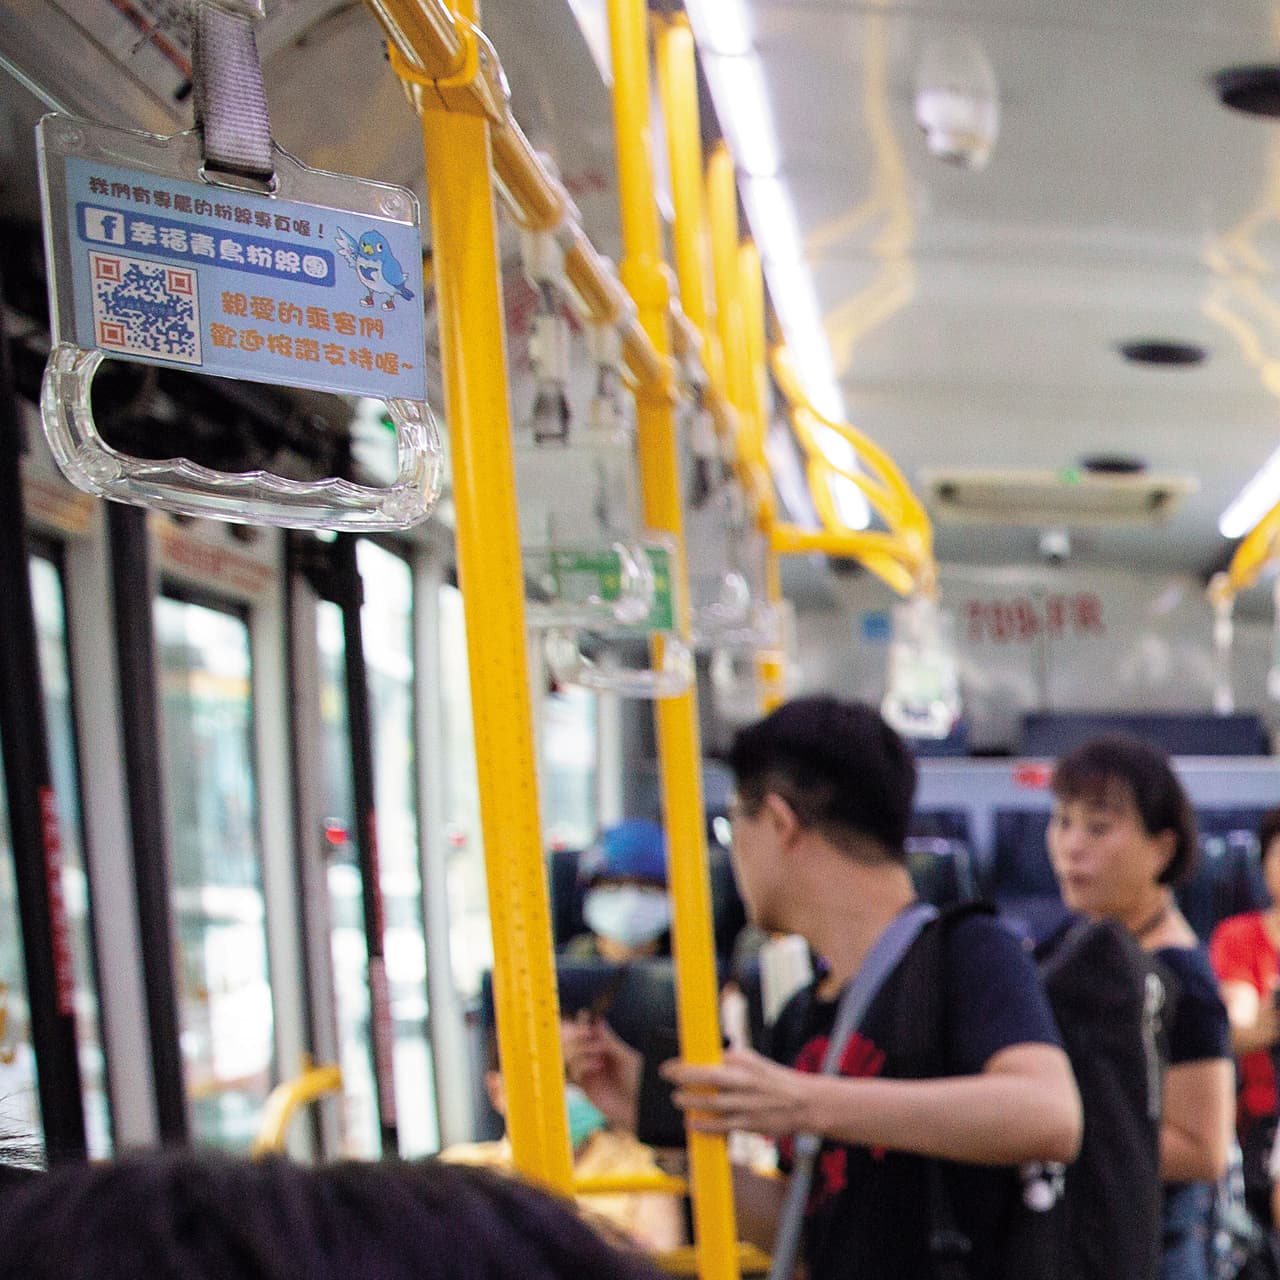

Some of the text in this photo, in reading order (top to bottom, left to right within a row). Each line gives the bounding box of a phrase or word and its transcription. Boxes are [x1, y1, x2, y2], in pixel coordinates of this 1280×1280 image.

[129, 220, 329, 280] 幸福青鳥粉絲團
[220, 290, 385, 340] 親愛的乘客們
